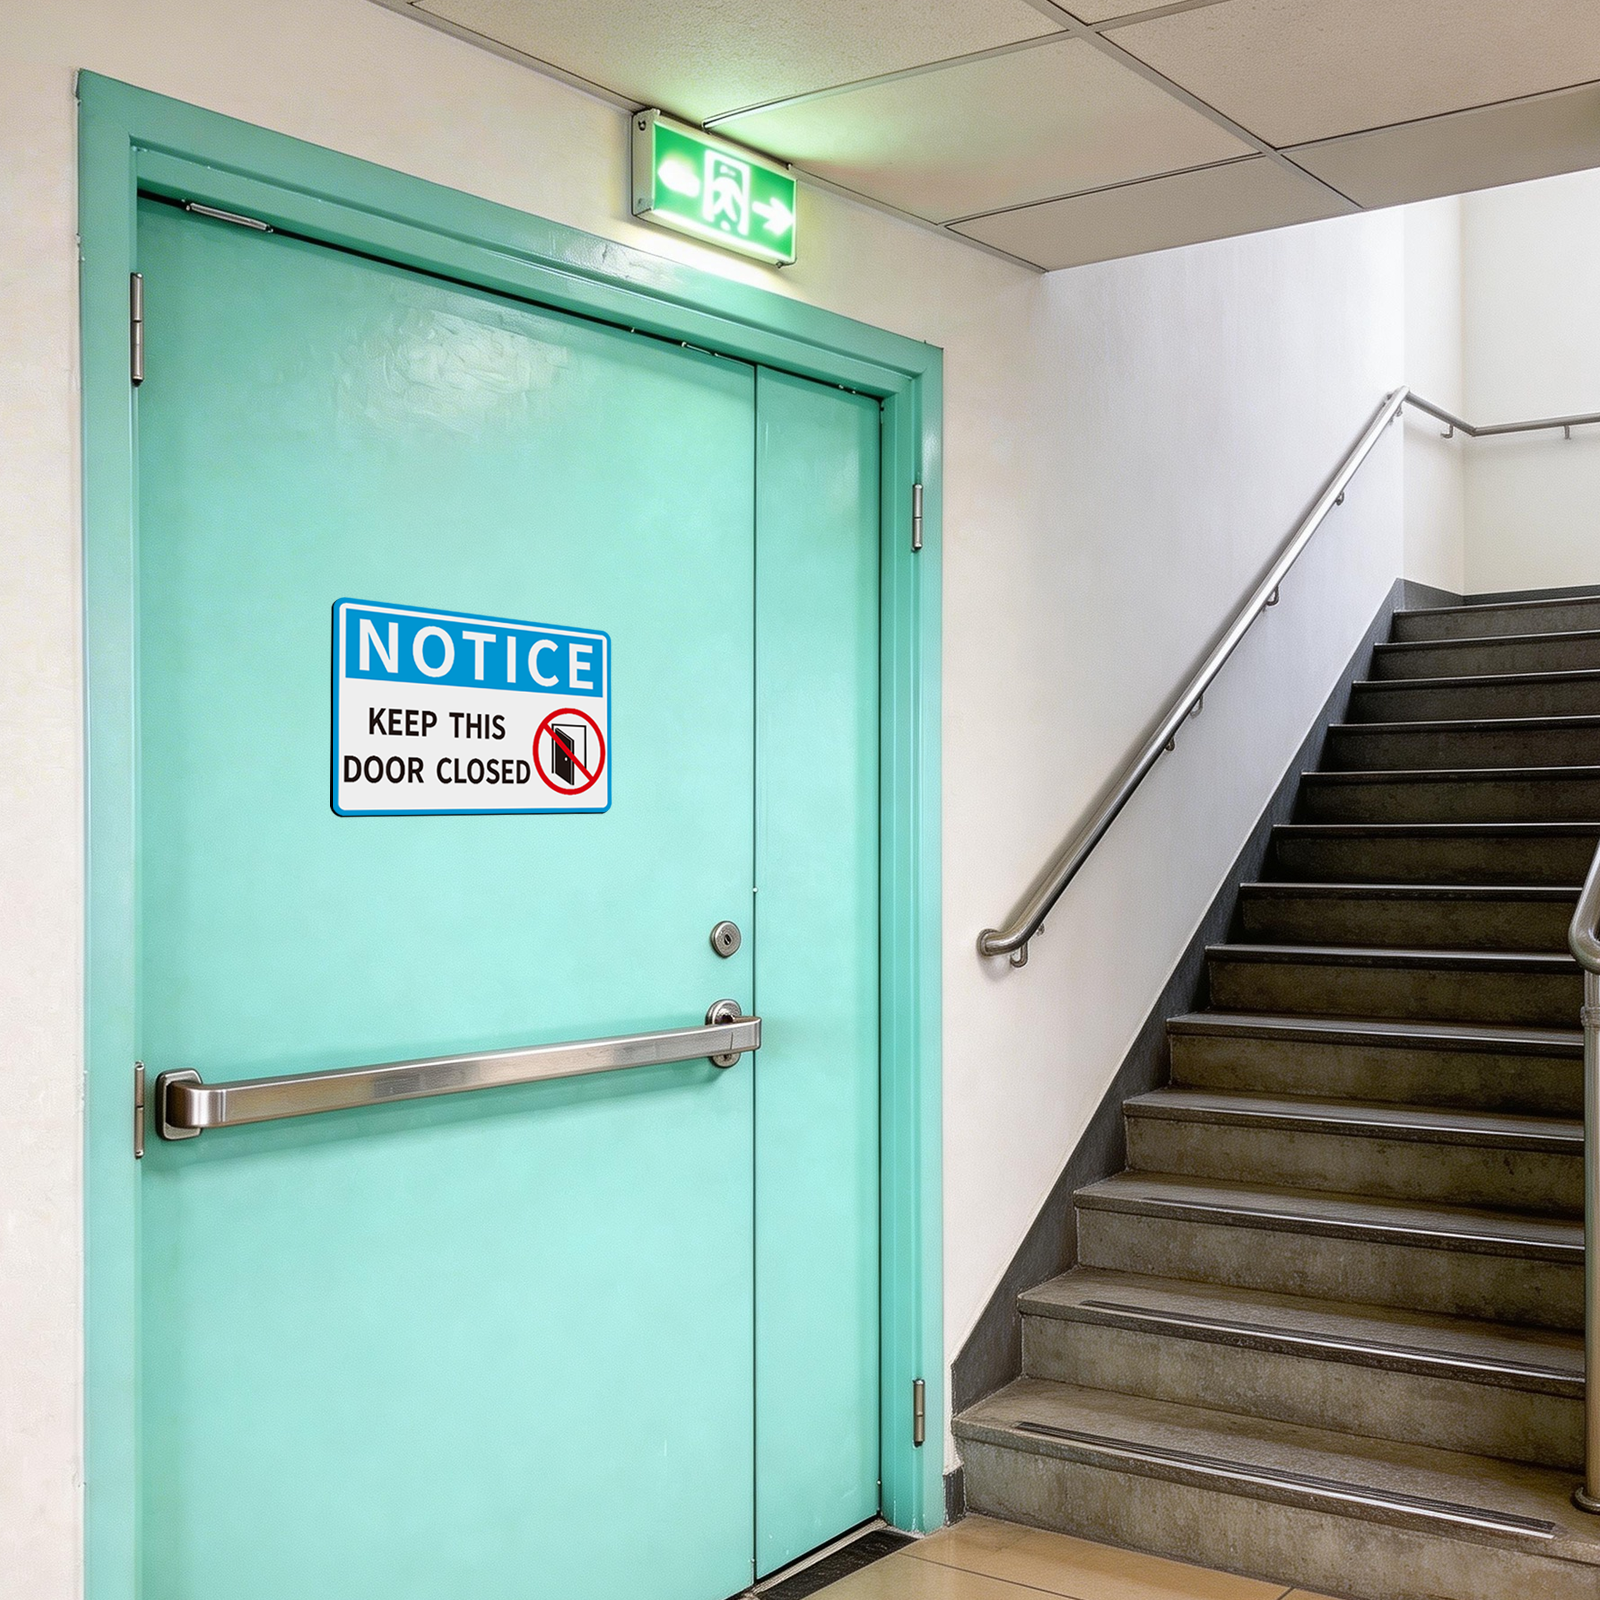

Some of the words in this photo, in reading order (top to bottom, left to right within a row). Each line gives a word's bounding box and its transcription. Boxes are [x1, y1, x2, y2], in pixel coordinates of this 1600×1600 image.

[359, 618, 594, 690] NOTICE
[368, 706, 438, 737] KEEP
[448, 711, 506, 740] THIS
[343, 755, 425, 784] DOOR
[436, 757, 531, 785] CLOSED
